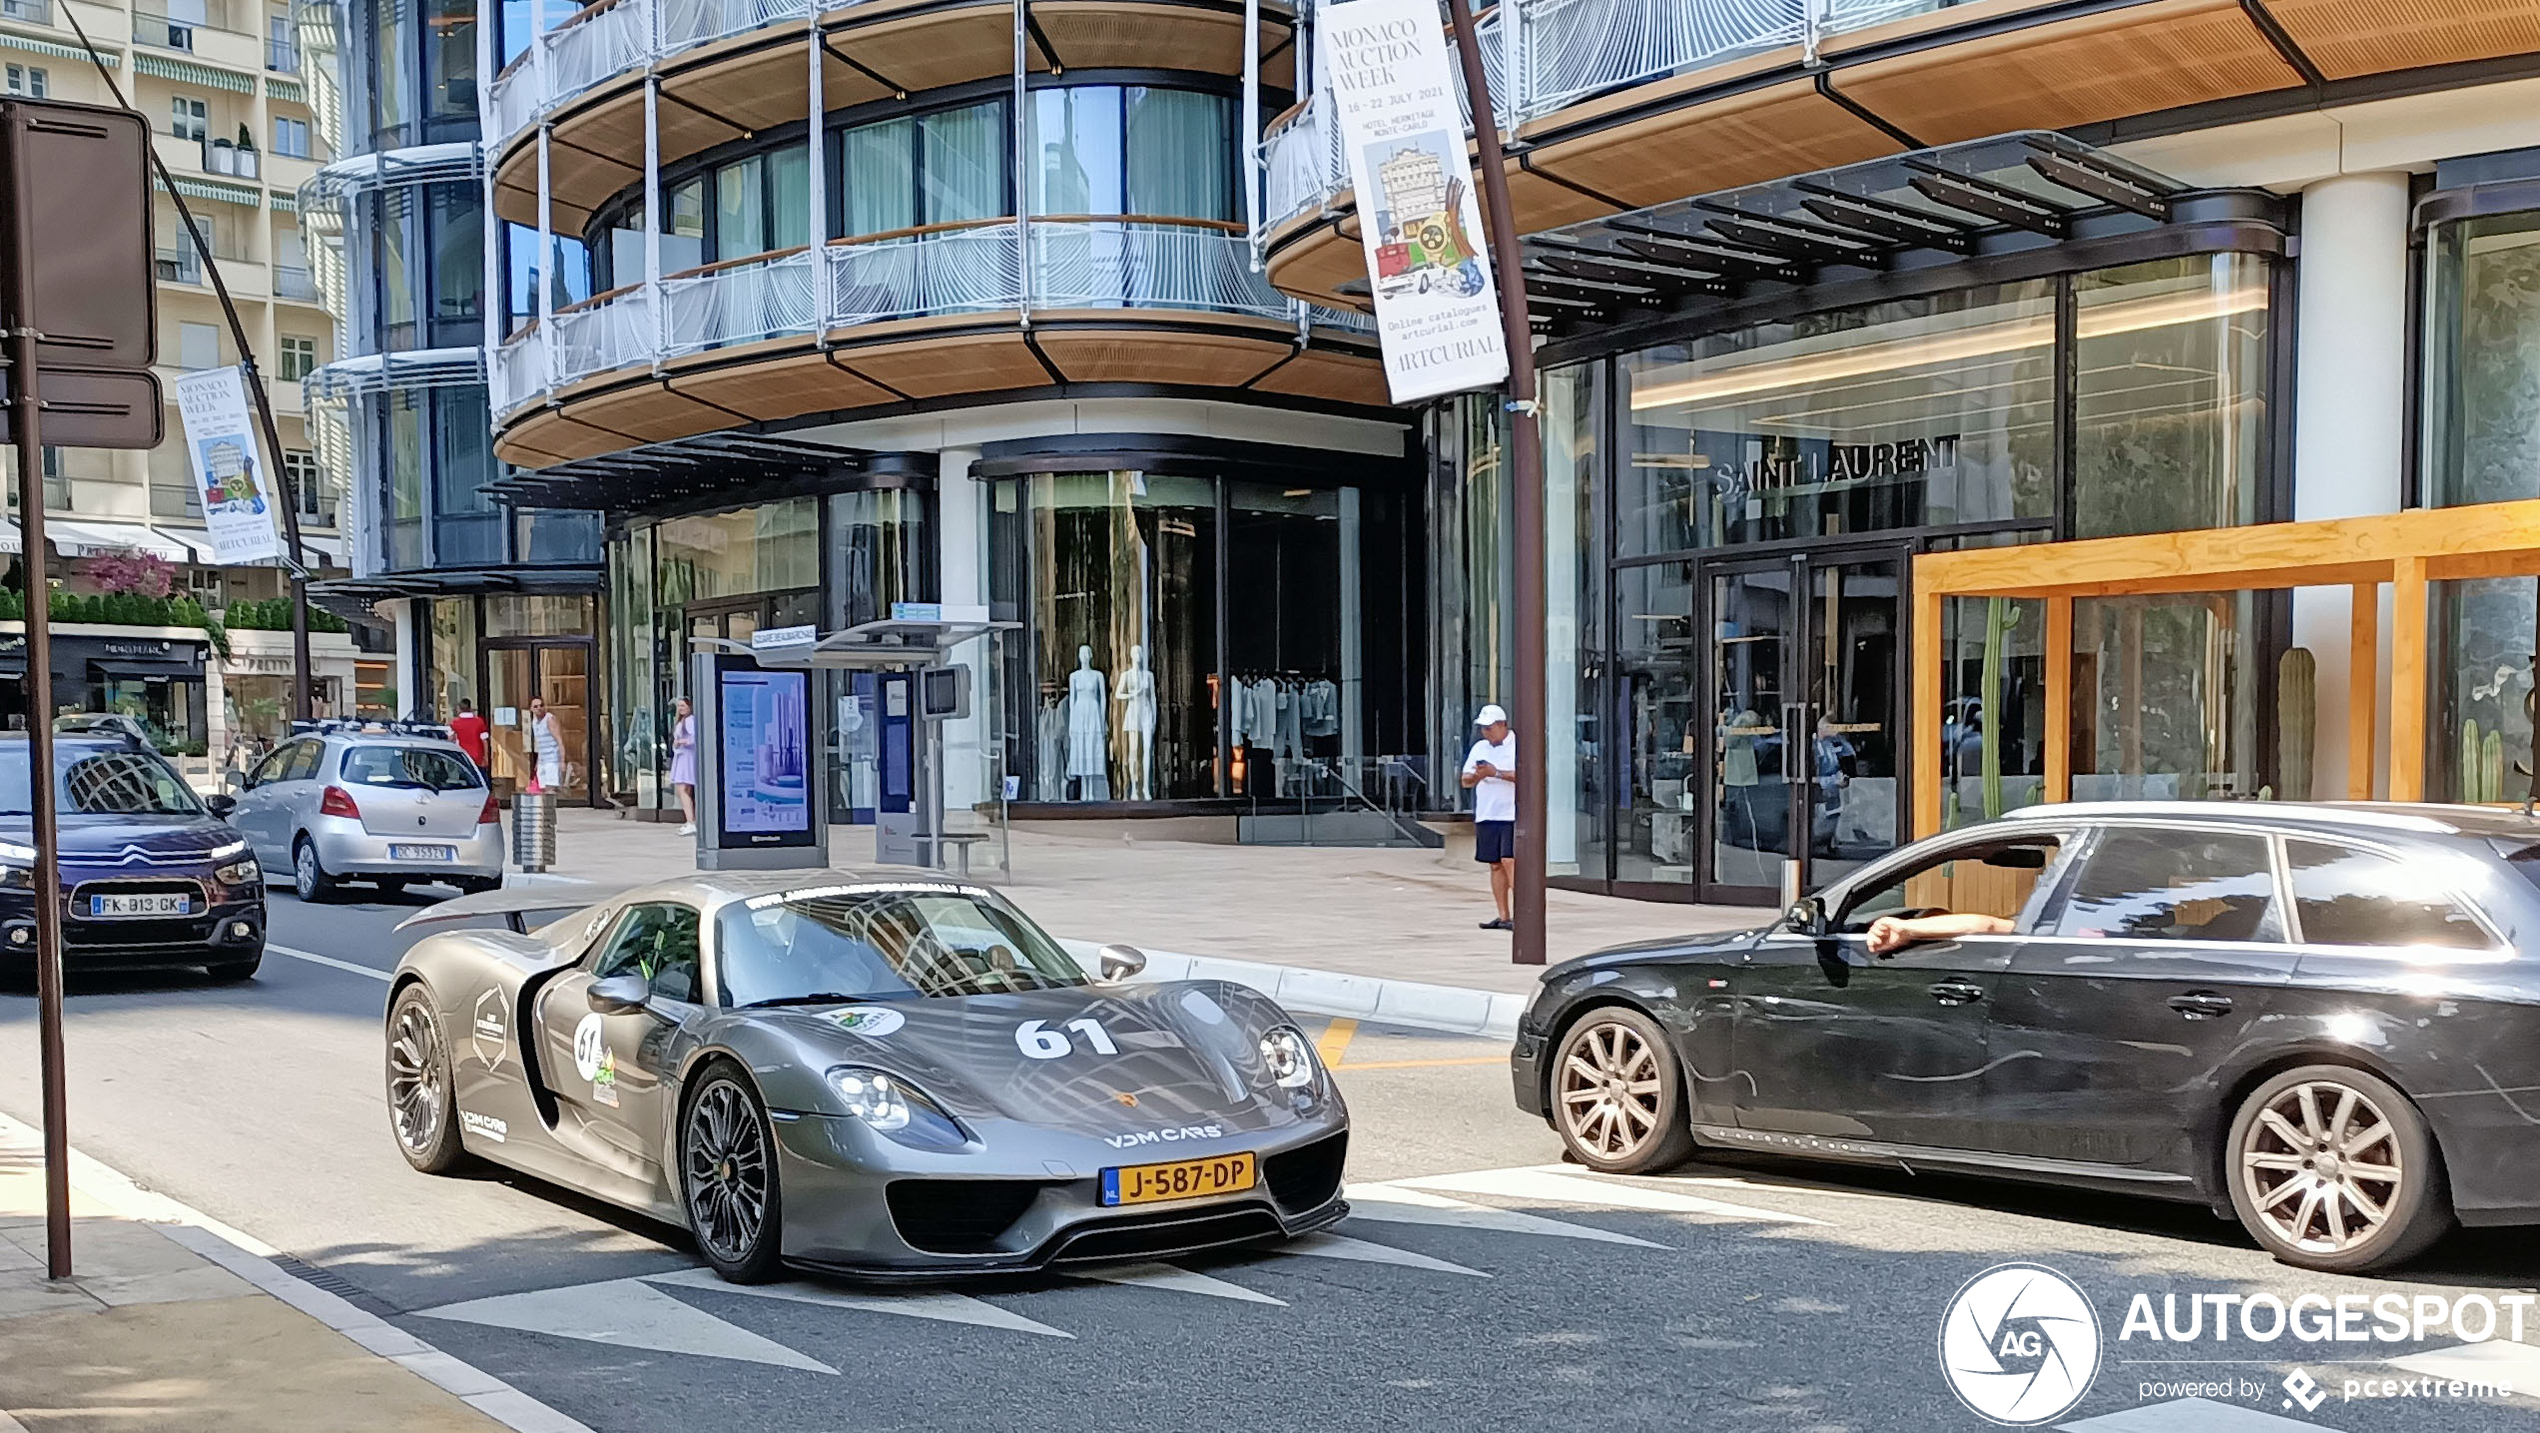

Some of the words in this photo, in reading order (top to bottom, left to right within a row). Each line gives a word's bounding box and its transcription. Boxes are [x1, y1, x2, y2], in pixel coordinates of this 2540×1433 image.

[1331, 18, 1417, 50] MONACO
[1337, 39, 1422, 71] AUCTION
[1339, 65, 1397, 91] WEEK
[1348, 102, 1360, 113] 16
[1371, 98, 1383, 109] 22
[1390, 92, 1412, 106] JULY
[1419, 86, 1444, 99] 2021
[1363, 119, 1386, 130] HOTEL
[1391, 110, 1435, 125] HERMITAGE
[1374, 121, 1428, 137] MONTE-CARLO
[1388, 318, 1423, 331] Online
[1429, 304, 1488, 321] catalogues
[1402, 318, 1478, 340] artcurial.com
[1393, 336, 1500, 374] ARTCURIAL
[1716, 452, 1803, 496] SAINT
[1810, 434, 1963, 485] LAURENT
[578, 1027, 596, 1063] 61
[1014, 1018, 1119, 1060] 61
[1103, 1133, 1160, 1149] VDM
[1129, 1160, 1245, 1198] J-587-DP
[1105, 1189, 1119, 1200] NL
